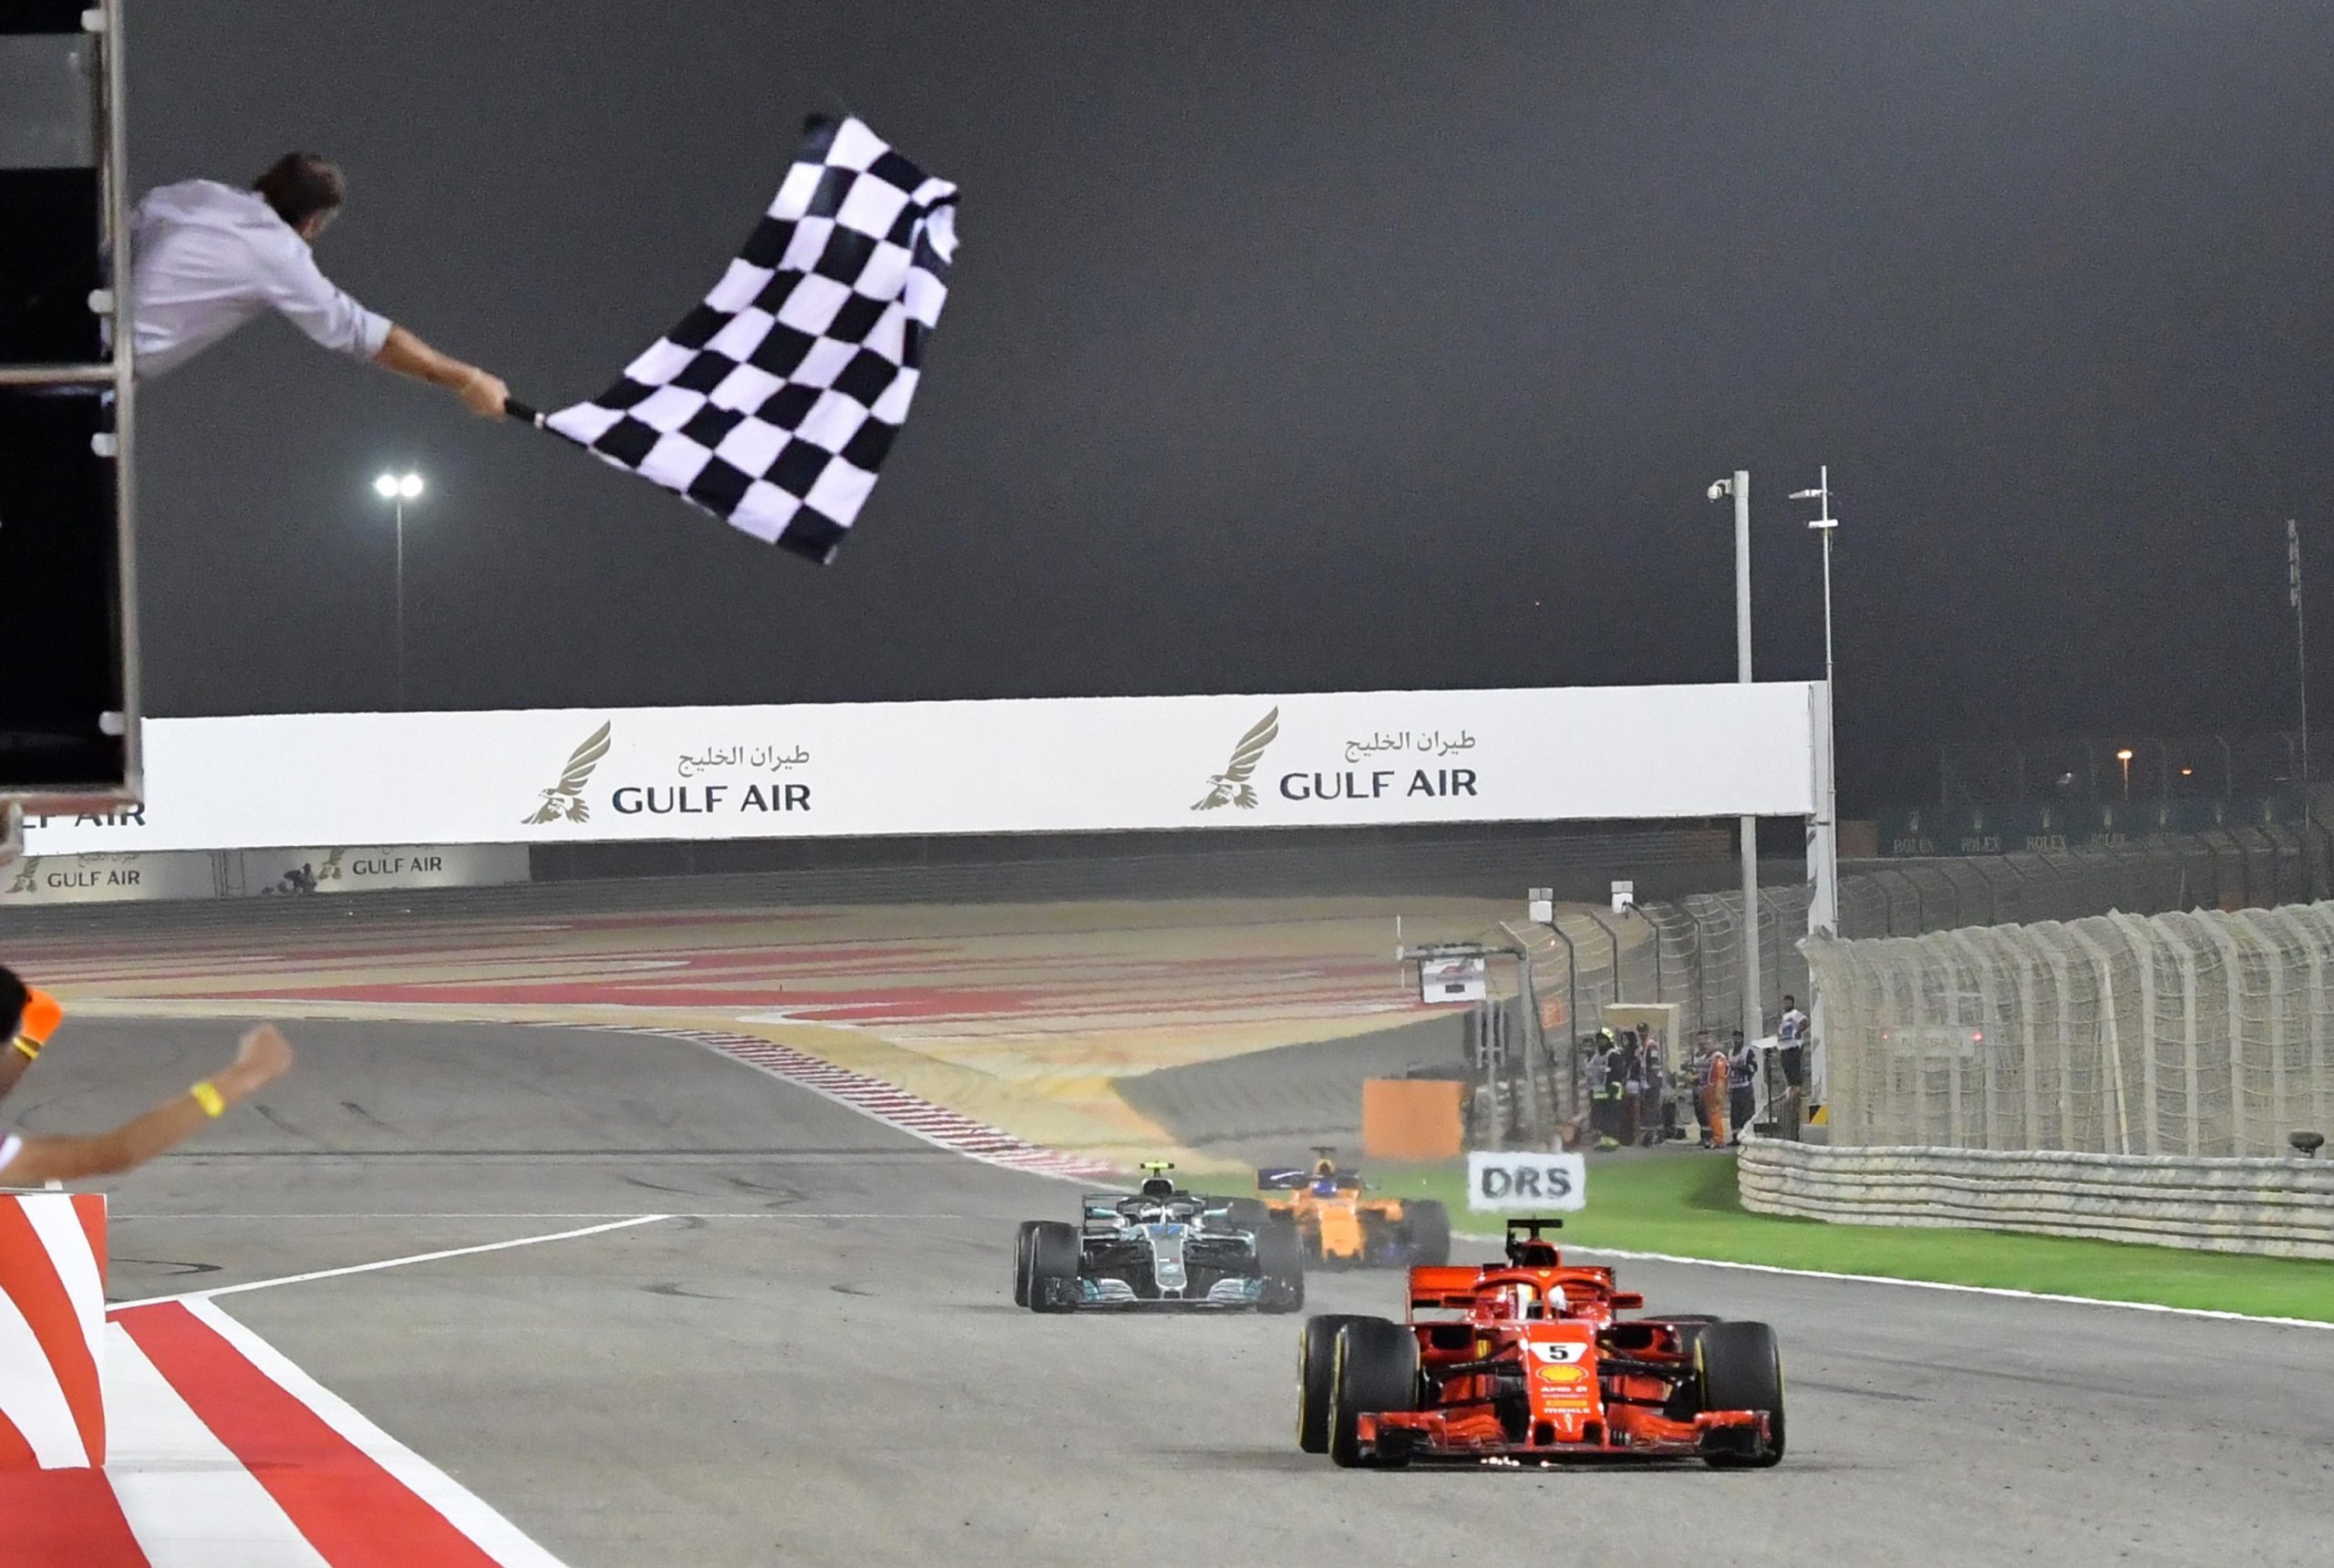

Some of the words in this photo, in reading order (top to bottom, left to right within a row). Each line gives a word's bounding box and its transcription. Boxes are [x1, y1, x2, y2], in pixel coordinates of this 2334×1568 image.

[1345, 731, 1410, 763] الخليج
[1417, 729, 1475, 757] طيران
[677, 746, 744, 778] الخليج
[750, 745, 810, 772] طيران
[1279, 770, 1395, 800] GULF
[1407, 769, 1478, 797] AIR
[612, 785, 728, 814] GULF
[739, 784, 811, 812] AIR
[2026, 834, 2066, 851] ROLEX
[47, 871, 102, 888] GULF
[107, 870, 140, 886] AIR
[353, 858, 406, 875] GULF
[410, 856, 442, 872] AIR
[1482, 1166, 1572, 1200] DRS
[1549, 1345, 1569, 1360] 5
